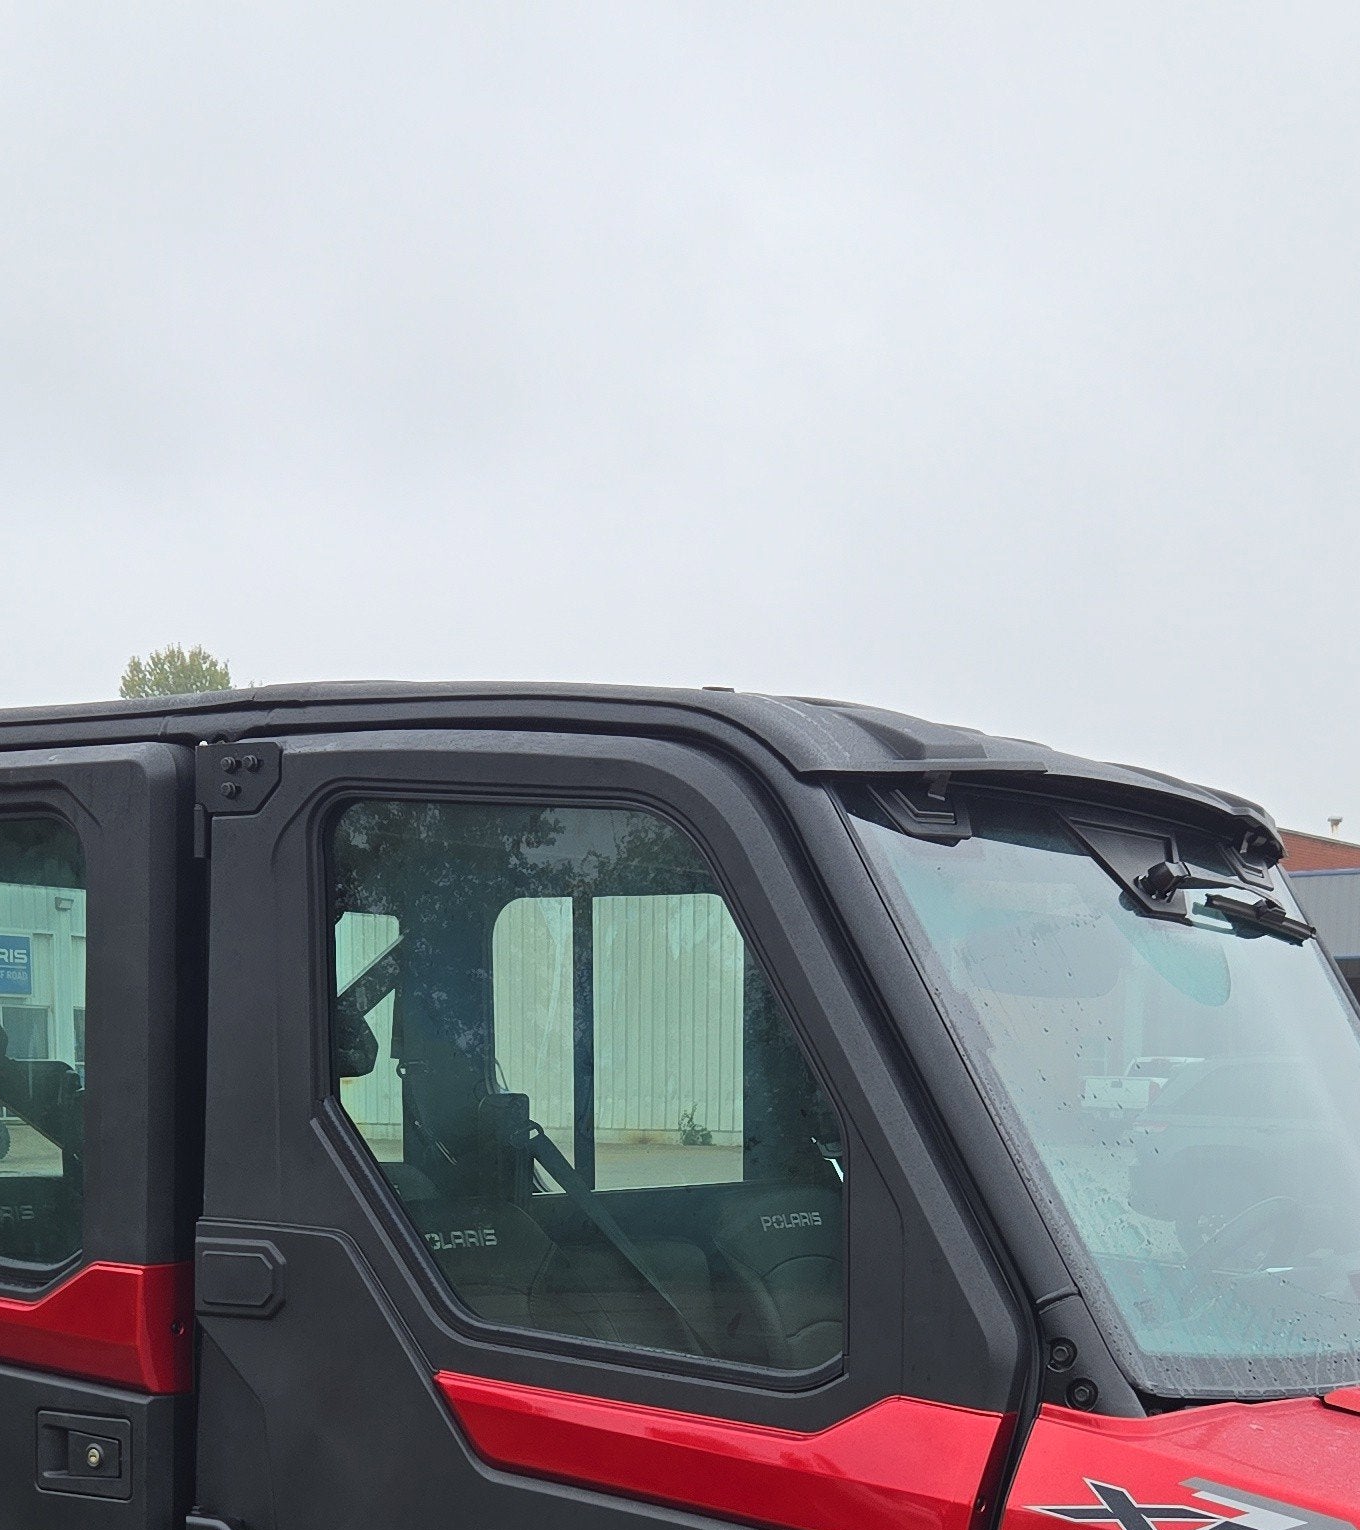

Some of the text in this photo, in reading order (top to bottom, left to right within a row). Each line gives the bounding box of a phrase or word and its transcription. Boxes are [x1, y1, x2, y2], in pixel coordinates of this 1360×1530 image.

[6, 970, 29, 981] ROAD
[760, 1211, 822, 1232] POLARIS
[424, 1229, 498, 1250] OLARIS
